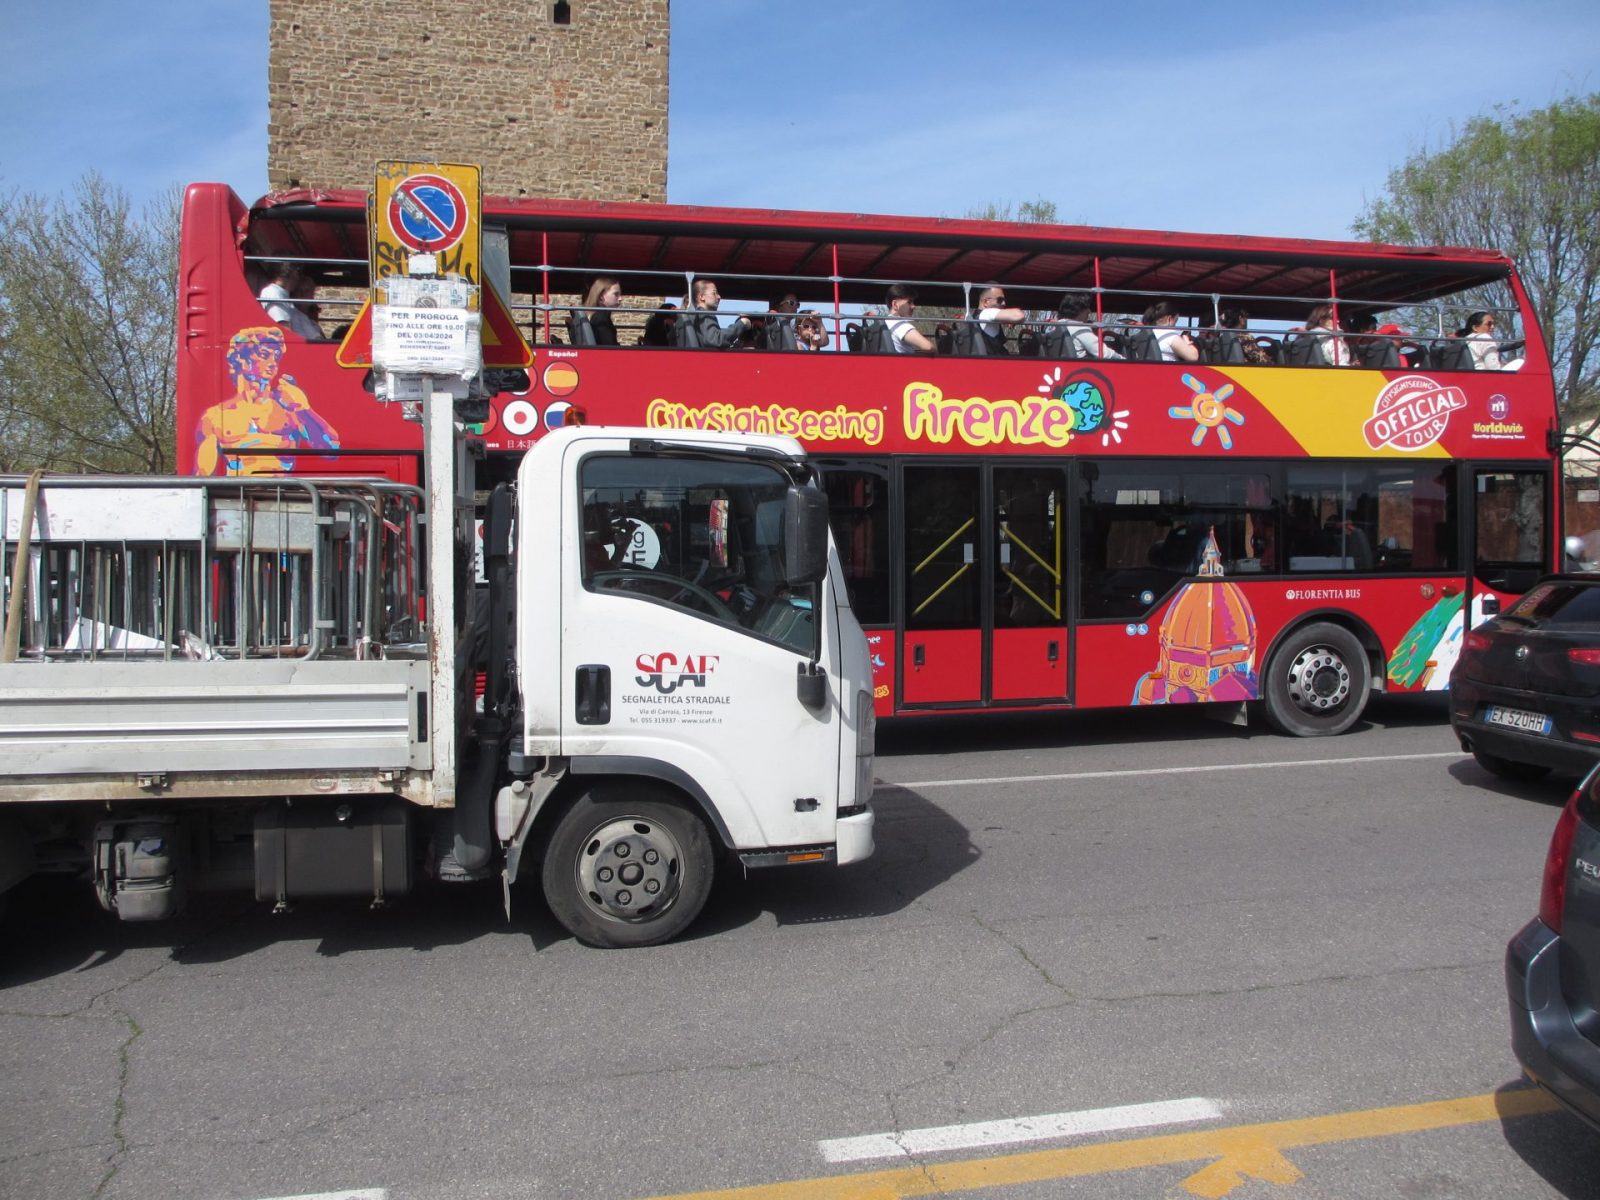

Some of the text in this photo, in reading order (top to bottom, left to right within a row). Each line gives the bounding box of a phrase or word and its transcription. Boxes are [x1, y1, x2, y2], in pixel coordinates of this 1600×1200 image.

[414, 313, 459, 321] PROROGA
[548, 350, 578, 358] Español
[903, 382, 1074, 447] Firenze
[1374, 391, 1460, 440] OFFICIAL
[1405, 419, 1444, 444] TOUR
[1295, 589, 1361, 600] FLORENTIA BUS
[635, 652, 720, 694] SCAF
[622, 695, 731, 704] SEGNALETICA STRADALE
[1491, 708, 1545, 730] EX 520HH
